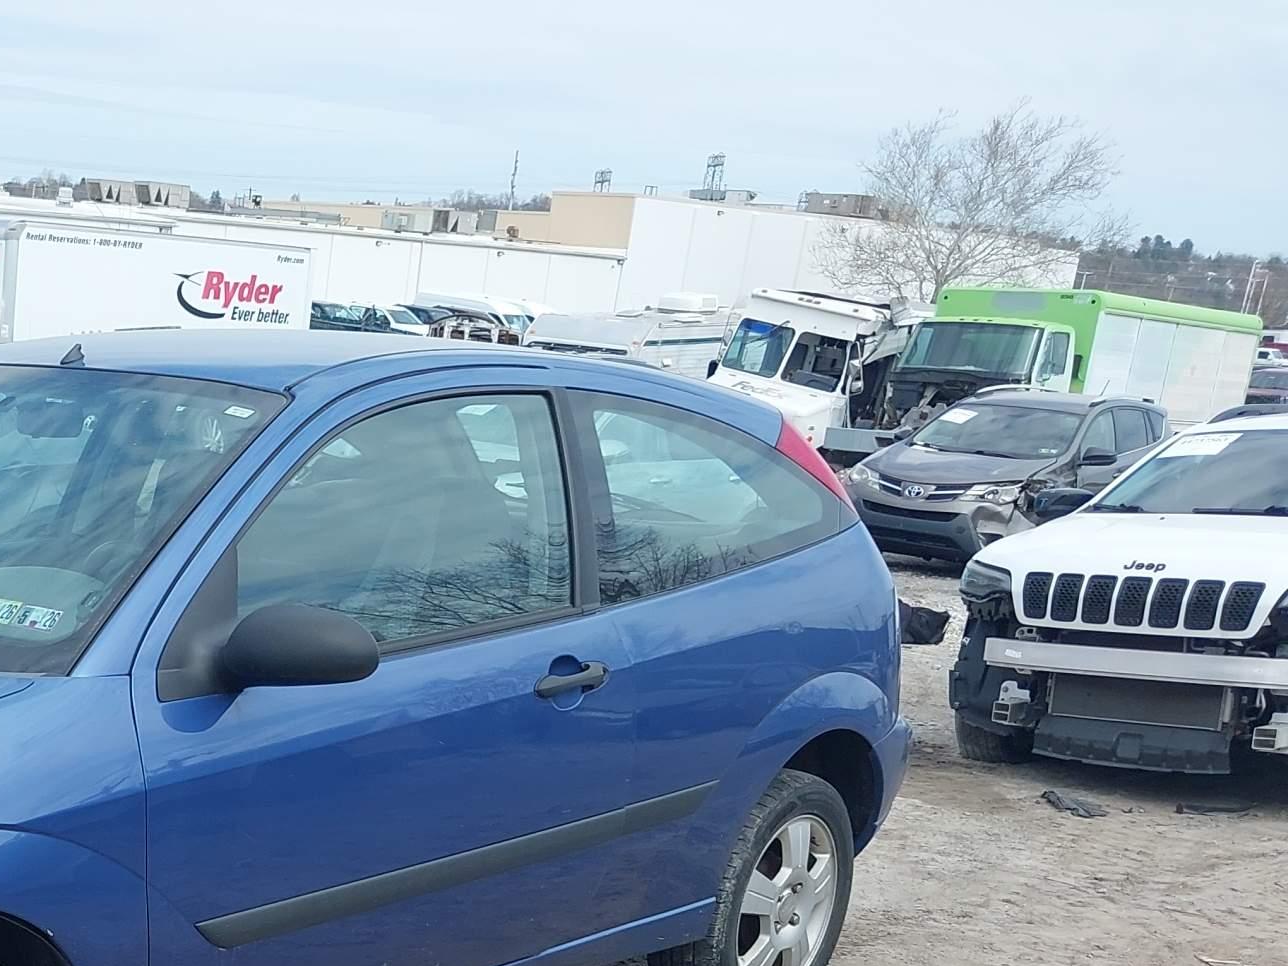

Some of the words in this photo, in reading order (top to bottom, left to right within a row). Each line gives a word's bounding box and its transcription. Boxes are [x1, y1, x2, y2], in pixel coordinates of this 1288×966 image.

[25, 232, 48, 241] Rental
[48, 234, 91, 246] Reservations:
[276, 254, 305, 265] Ryder.com
[201, 270, 284, 309] Ryder
[231, 306, 256, 321] Ever
[257, 308, 290, 325] better.
[1123, 560, 1167, 573] Jeep
